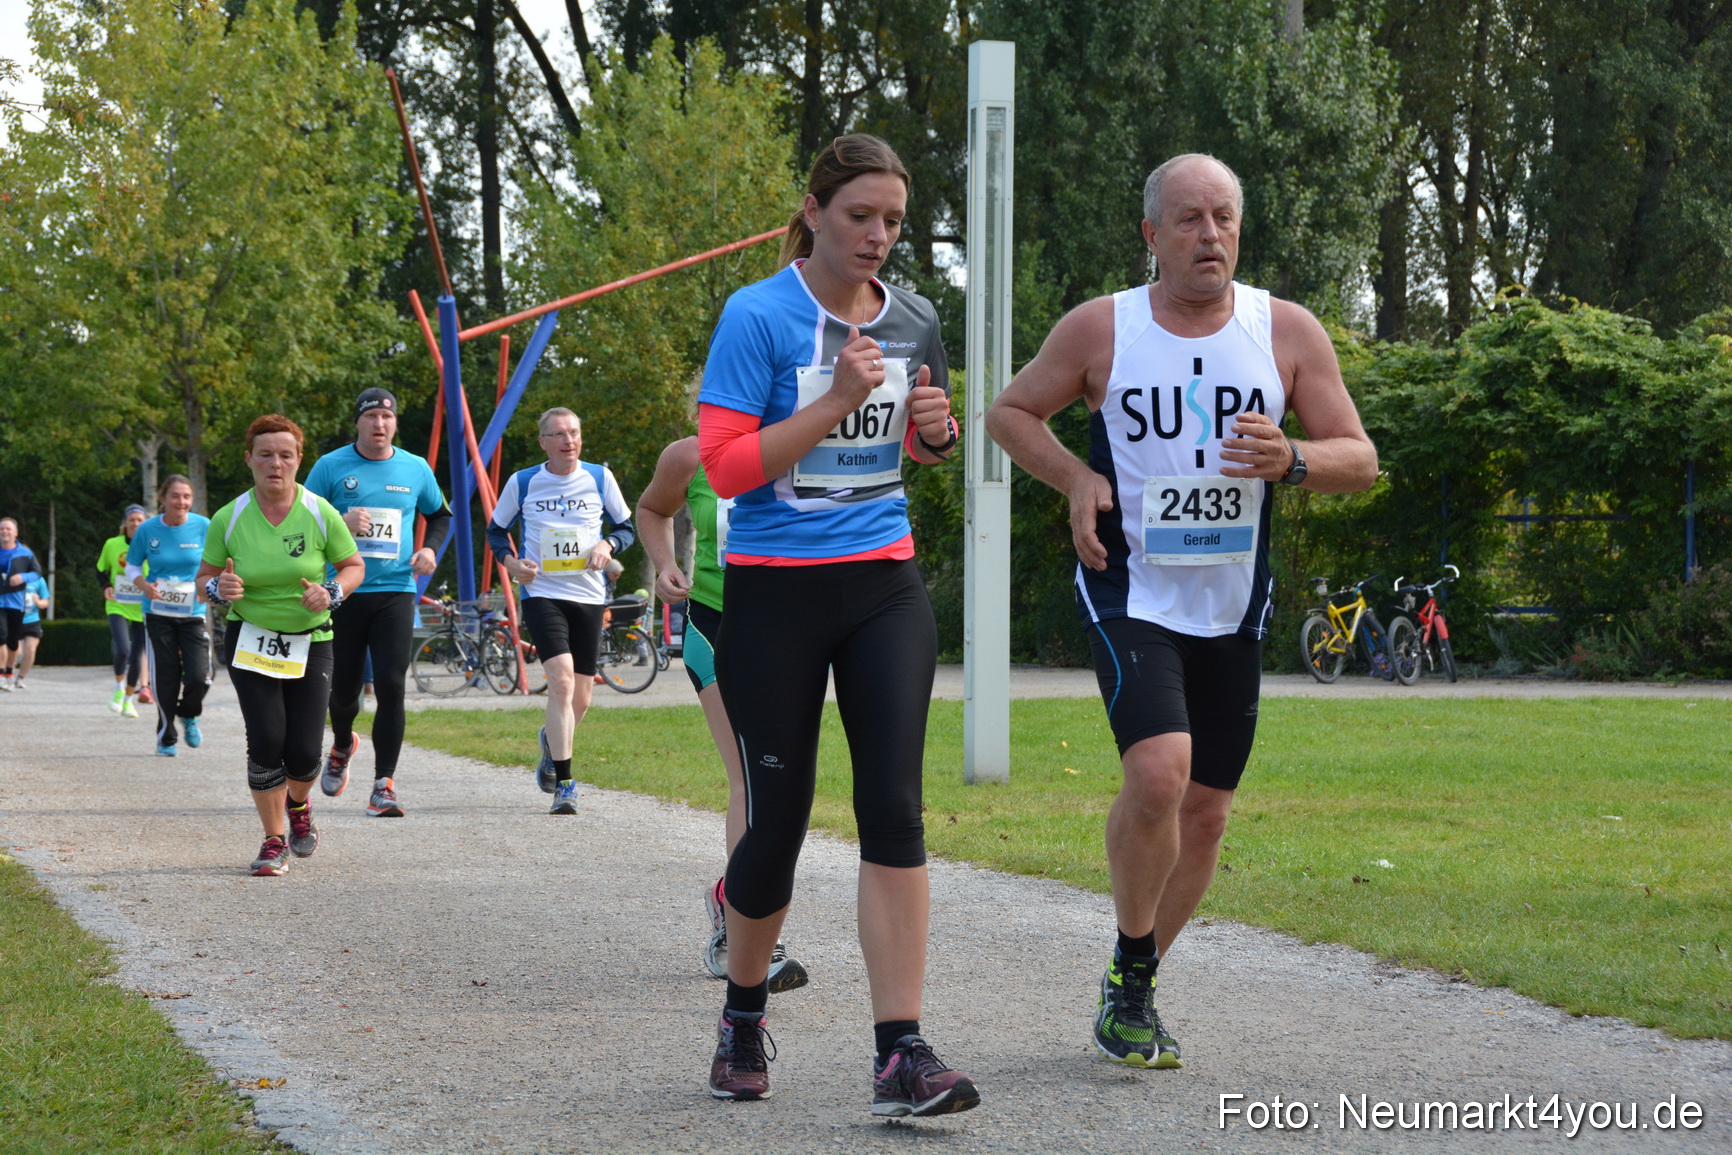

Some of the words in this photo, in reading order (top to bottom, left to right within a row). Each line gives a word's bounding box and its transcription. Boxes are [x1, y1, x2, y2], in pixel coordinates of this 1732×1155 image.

[824, 402, 895, 441] 067
[837, 452, 878, 467] Kathrin
[535, 496, 588, 513] SUSPA
[1160, 487, 1242, 521] 2433
[1148, 516, 1153, 524] D
[1183, 533, 1221, 546] Gerald
[553, 541, 580, 557] 144
[159, 590, 188, 604] 2367
[253, 657, 285, 670] Christine
